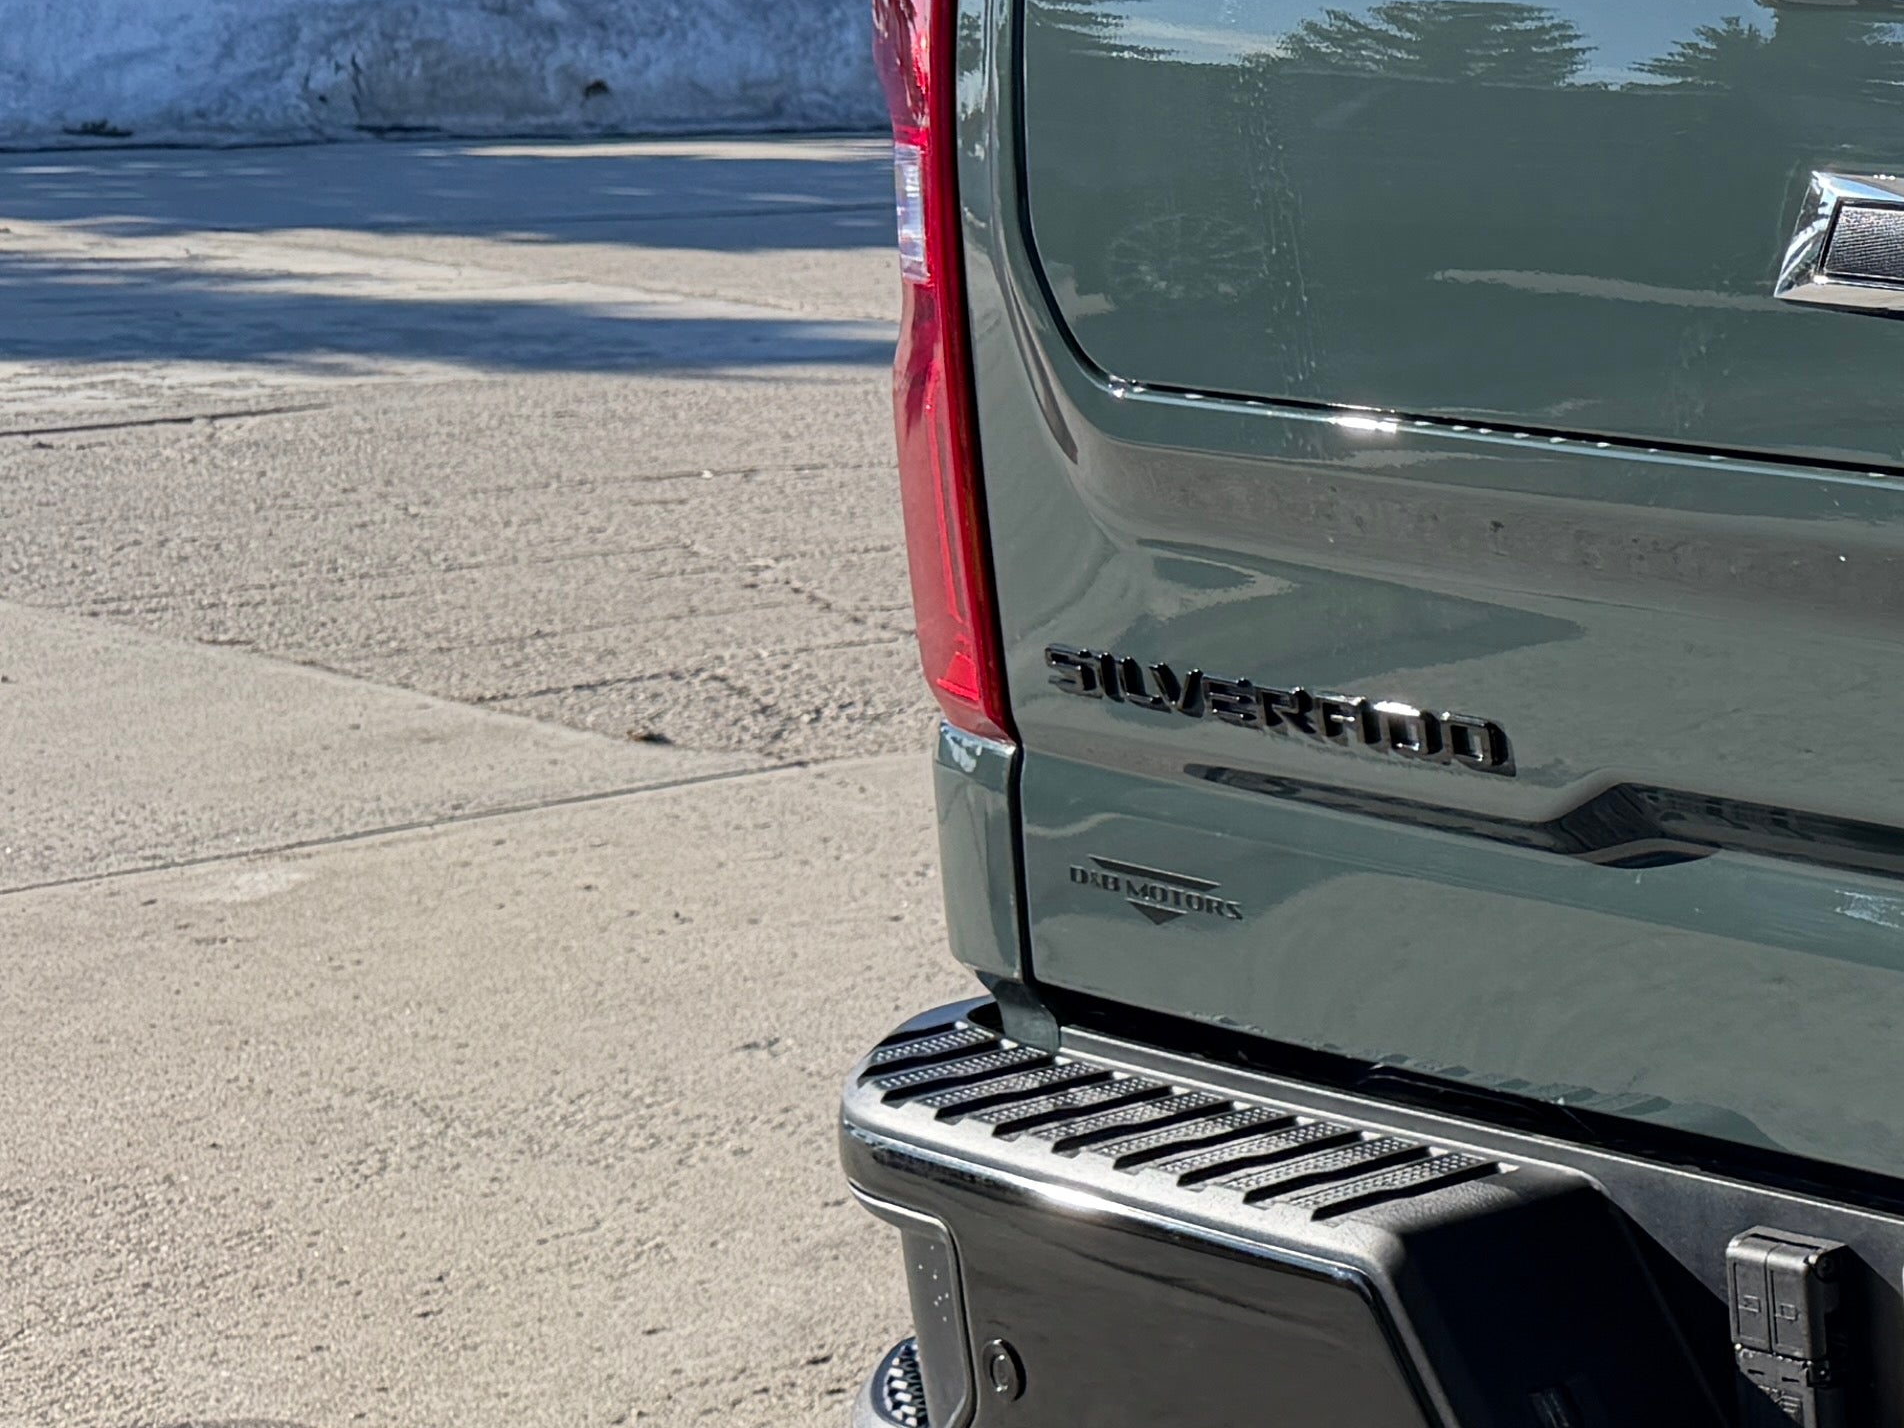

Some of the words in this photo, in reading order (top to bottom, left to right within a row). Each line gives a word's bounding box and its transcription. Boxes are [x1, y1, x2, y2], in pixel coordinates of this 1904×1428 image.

[1044, 643, 1516, 776] SILVERADO
[1069, 864, 1121, 893] D&B
[1125, 879, 1244, 920] MOTORS
